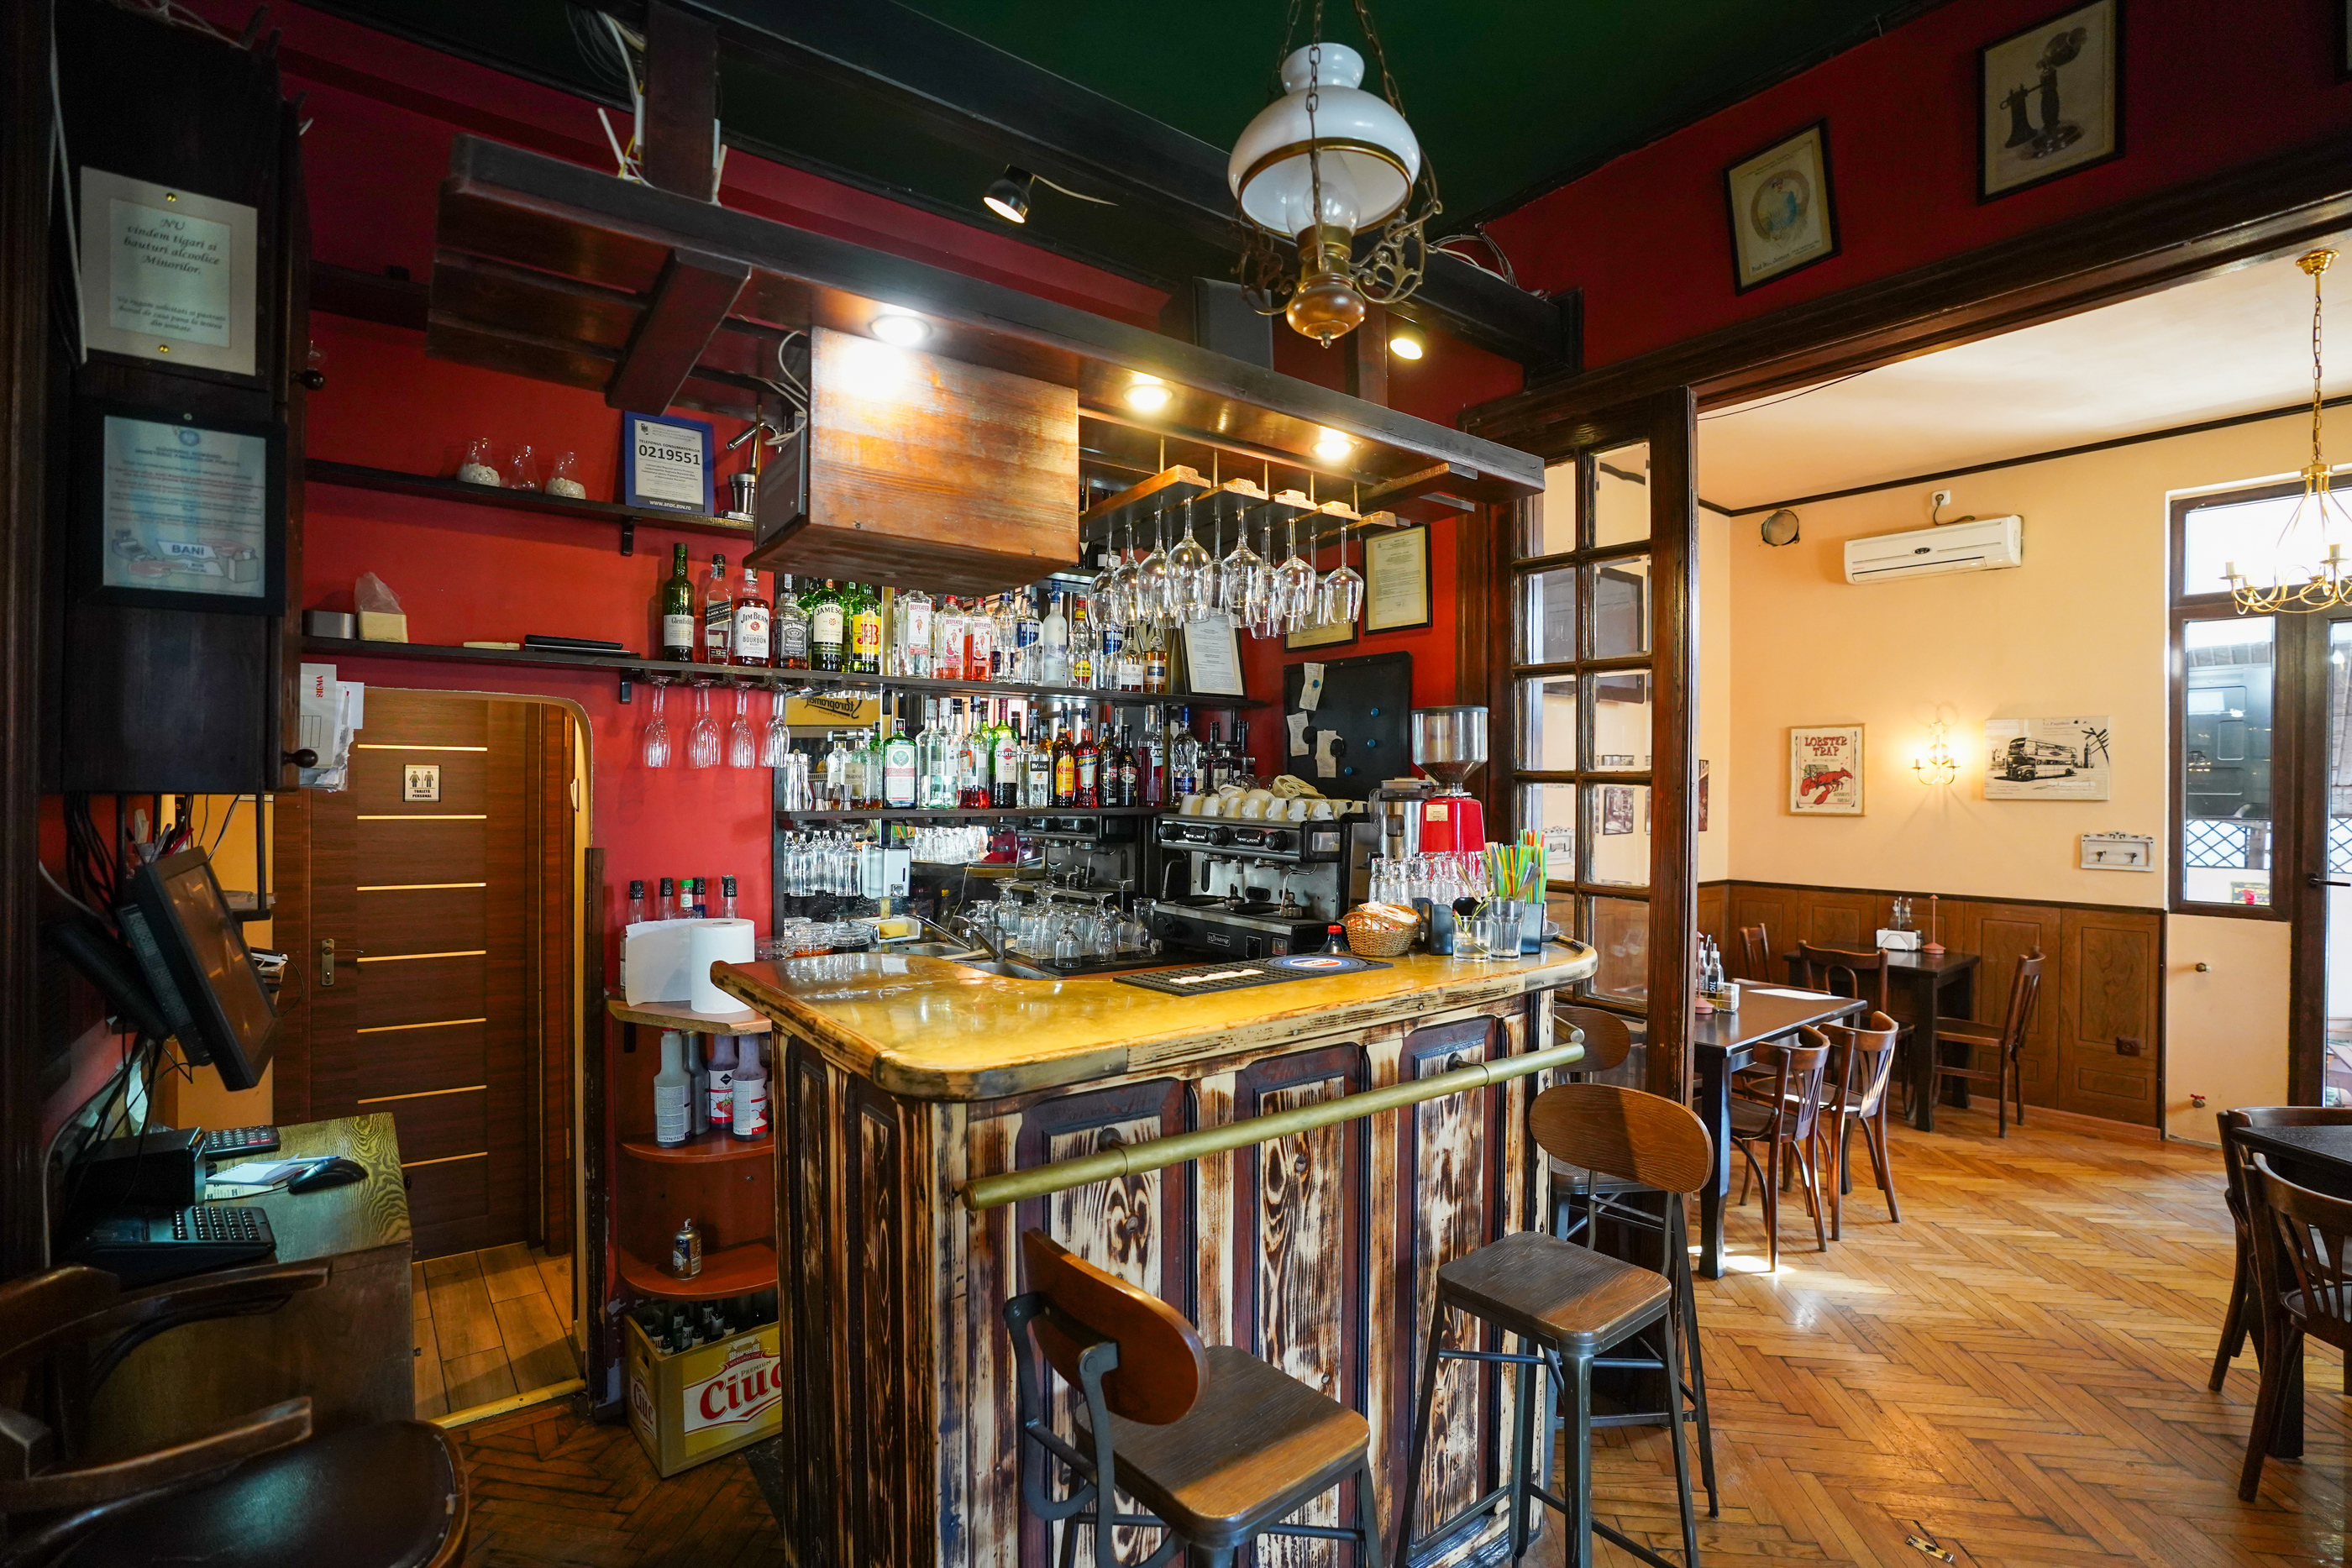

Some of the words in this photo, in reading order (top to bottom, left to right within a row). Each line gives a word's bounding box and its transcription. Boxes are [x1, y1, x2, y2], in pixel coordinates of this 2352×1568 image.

[161, 219, 185, 230] NU
[128, 226, 169, 241] vindem
[173, 235, 205, 249] tigari
[123, 236, 168, 254] bauturi
[171, 249, 220, 265] alcoolice
[639, 445, 701, 465] 0219551
[663, 443, 701, 454] CONSUMATORILOR
[171, 544, 204, 555] BANI
[740, 614, 753, 624] JIM
[753, 611, 769, 626] BEAM
[1804, 736, 1848, 747] LOBSTER
[1813, 747, 1840, 757] TRAP
[741, 1360, 771, 1377] PREMIUM
[633, 1383, 654, 1425] Ciuc
